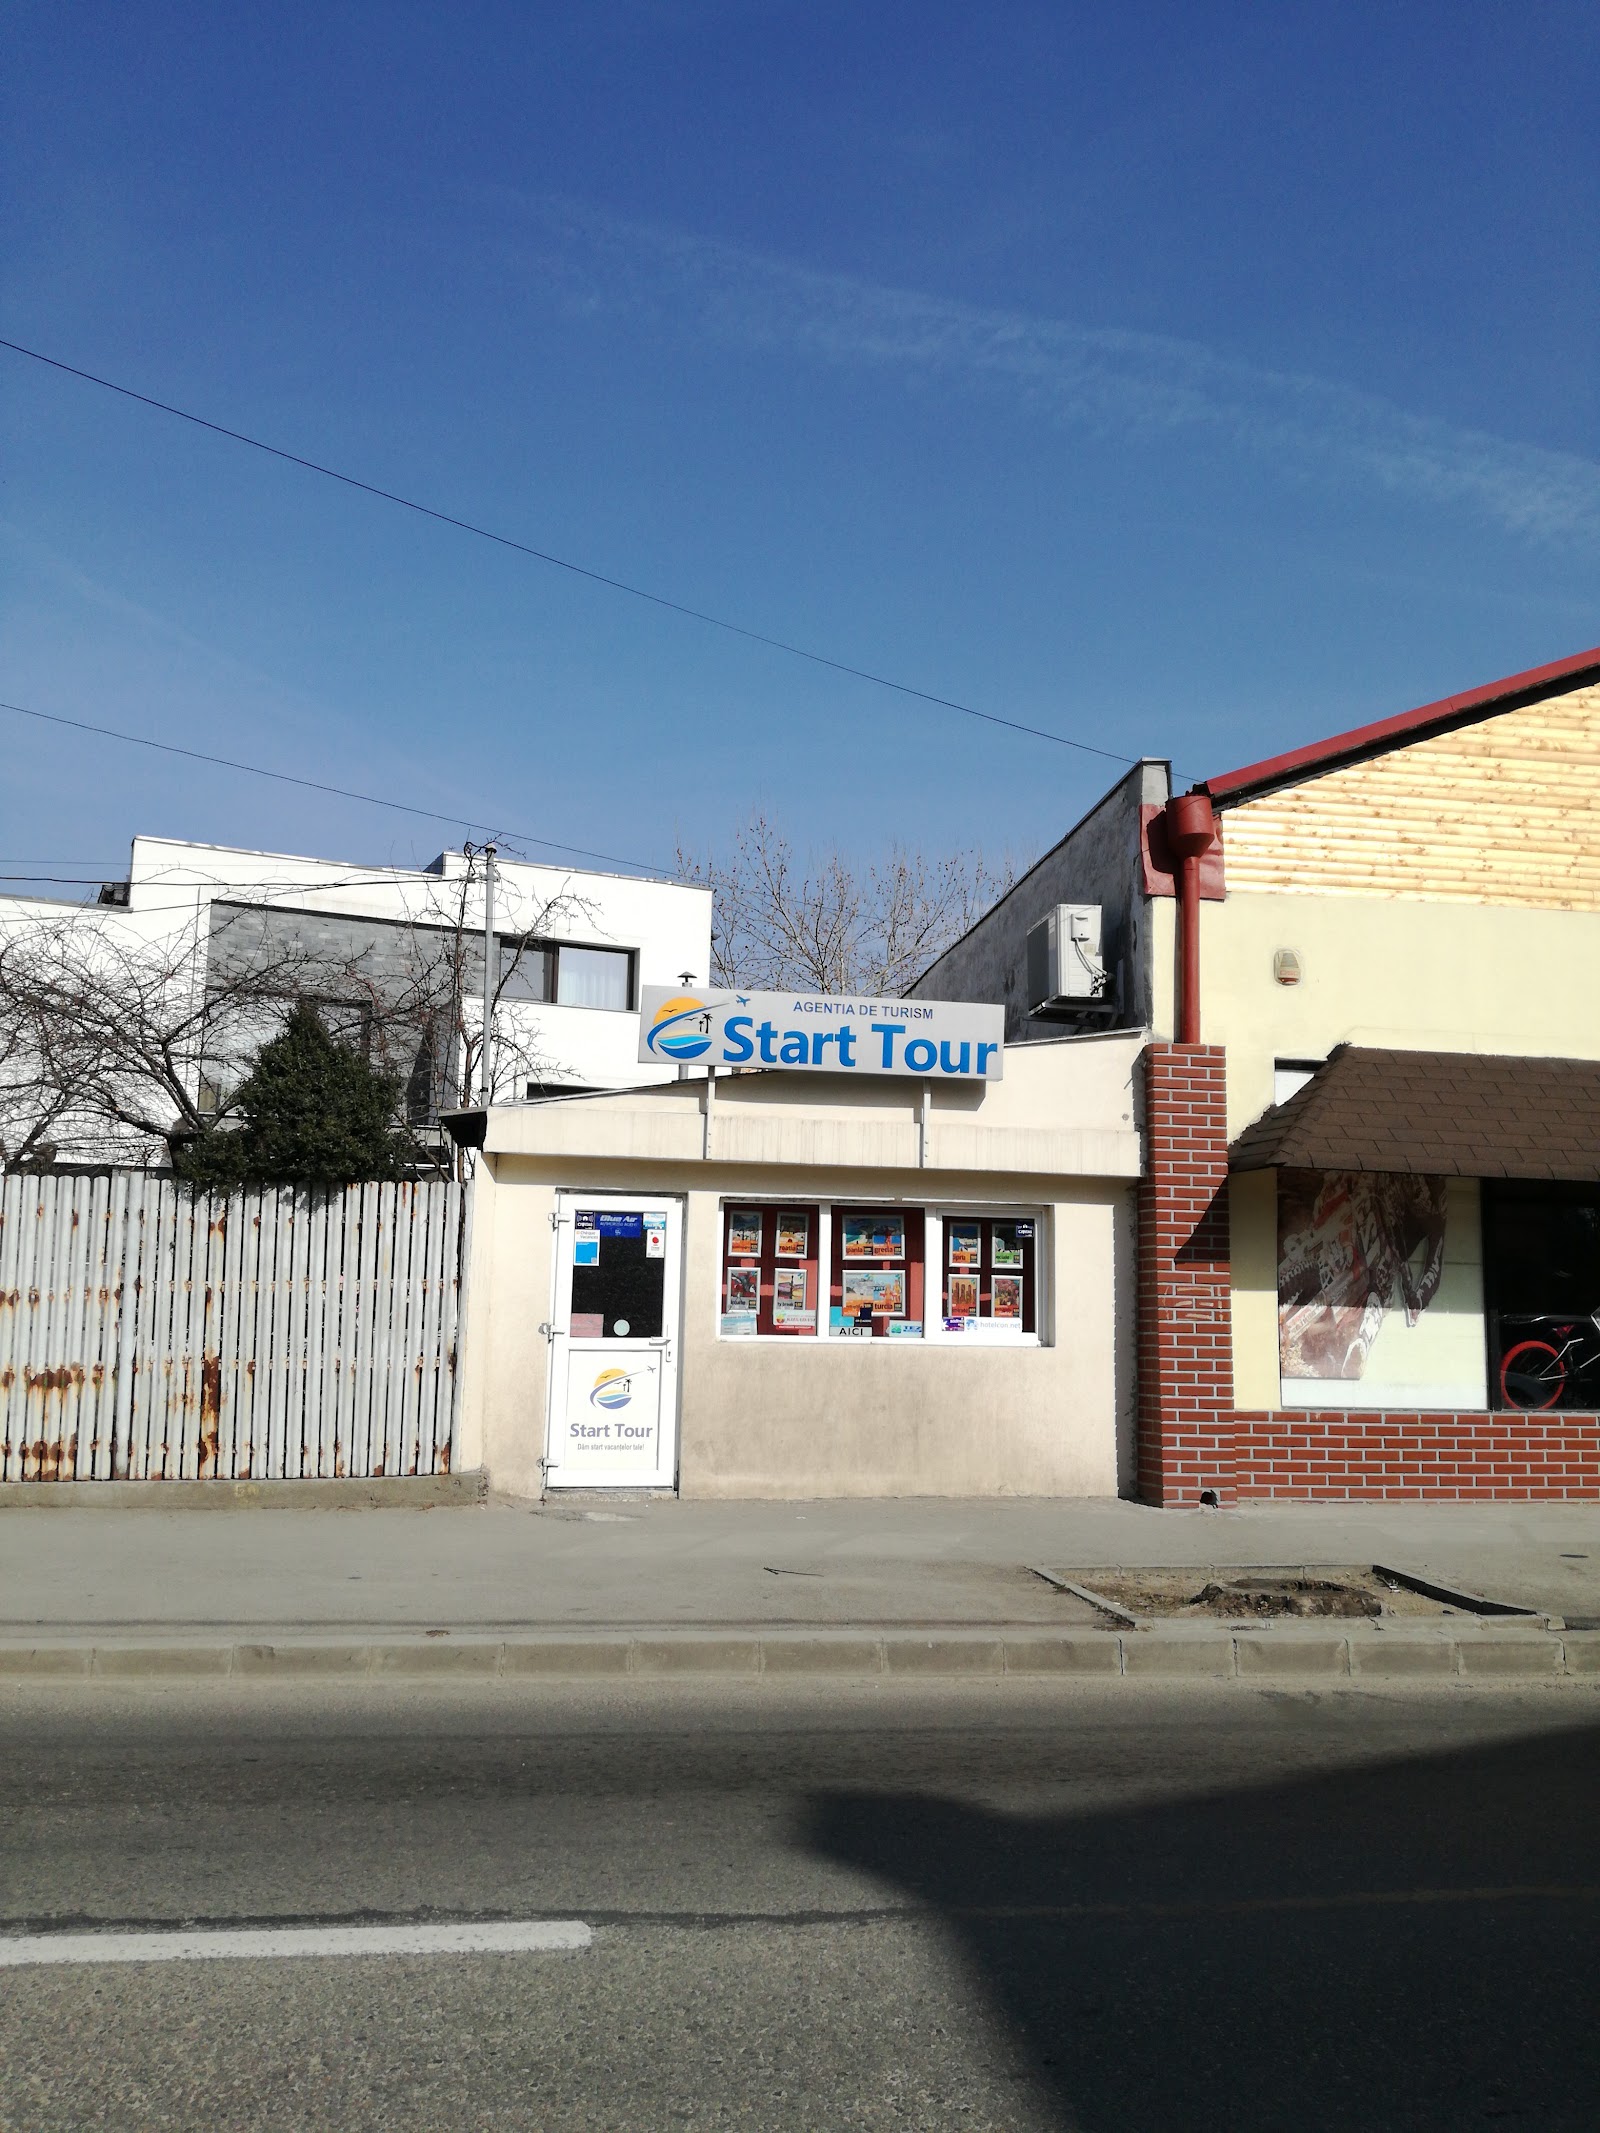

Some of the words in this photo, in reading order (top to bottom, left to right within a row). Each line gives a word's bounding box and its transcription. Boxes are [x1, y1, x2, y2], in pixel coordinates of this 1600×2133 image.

[793, 1001, 854, 1016] AGENTIA
[859, 1005, 878, 1017] DE
[881, 1006, 934, 1020] TURISM
[722, 1015, 857, 1067] Start
[871, 1023, 998, 1075] Tour
[839, 1327, 864, 1336] AICI
[569, 1423, 610, 1438] Start
[614, 1423, 653, 1438] Tour
